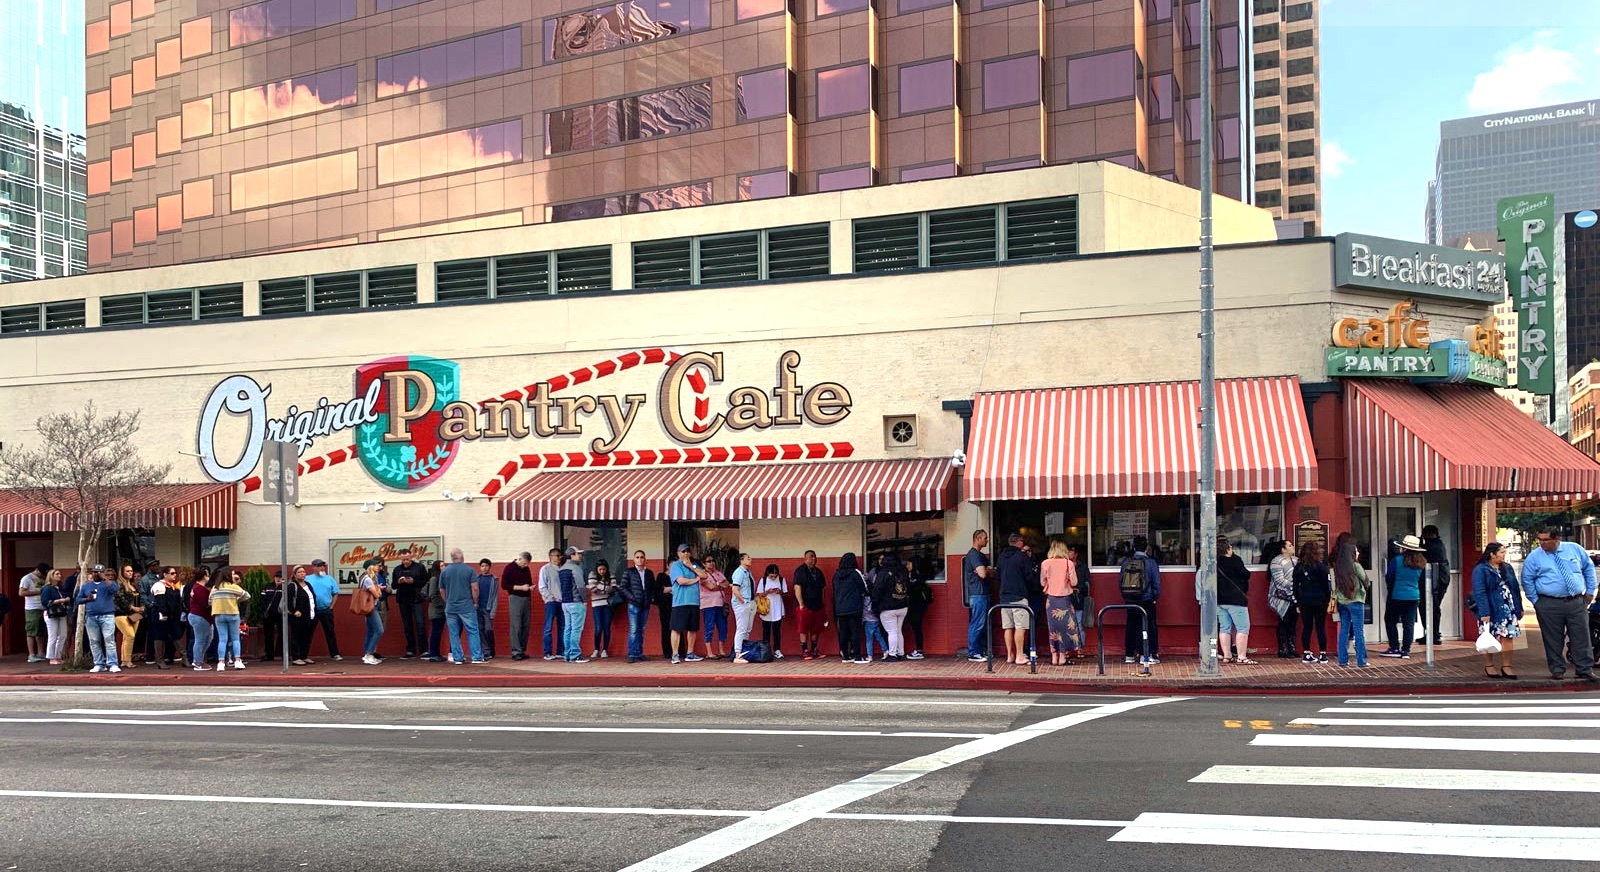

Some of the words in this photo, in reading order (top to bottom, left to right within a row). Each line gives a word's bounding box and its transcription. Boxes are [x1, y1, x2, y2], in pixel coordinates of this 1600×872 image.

[1504, 112, 1555, 124] NATIONAL
[1556, 106, 1586, 118] BANK
[1502, 196, 1549, 222] Original
[1351, 243, 1475, 290] Breakfast
[1519, 218, 1548, 380] PANTRY
[1345, 355, 1433, 373] PANTRY
[197, 374, 382, 483] Original
[381, 369, 646, 454] Pantry
[658, 350, 852, 444] Cafe
[378, 541, 434, 562] Patry
